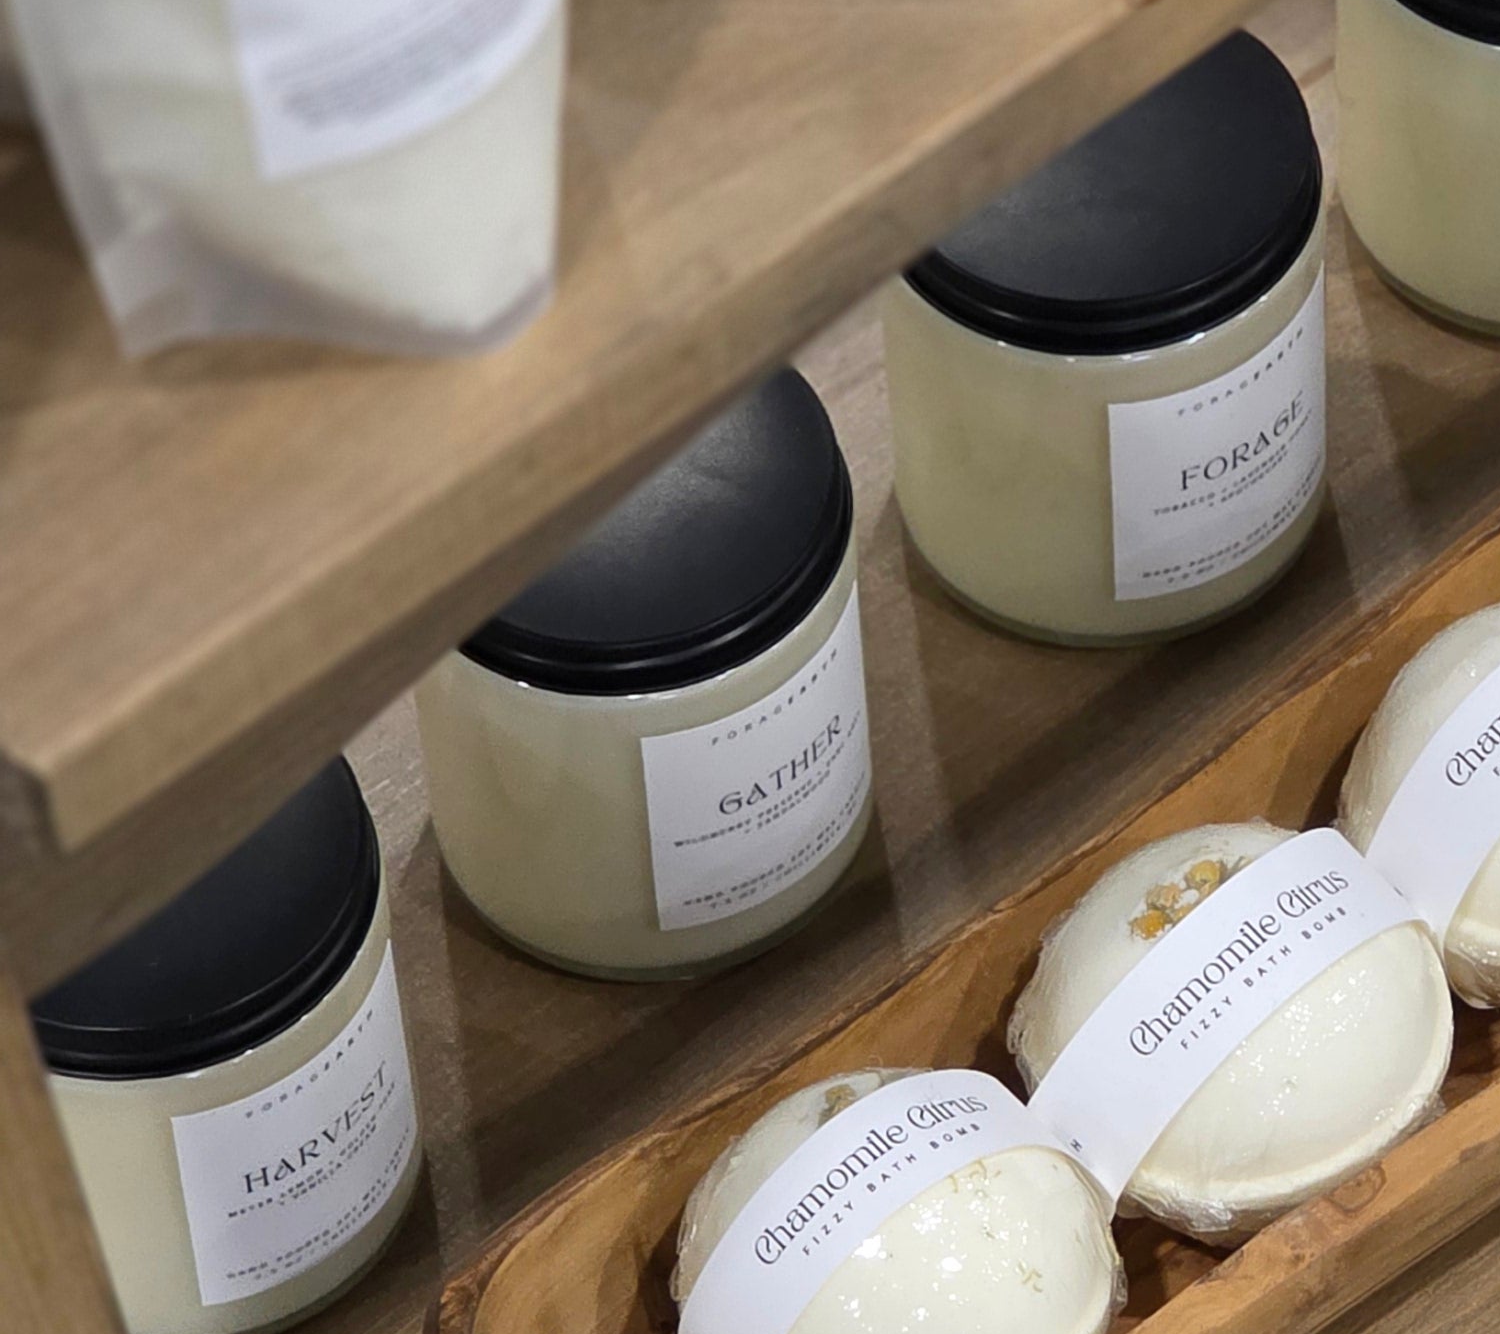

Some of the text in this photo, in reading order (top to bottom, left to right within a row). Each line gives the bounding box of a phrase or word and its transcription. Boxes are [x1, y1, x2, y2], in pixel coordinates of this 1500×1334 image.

[1152, 492, 1215, 514] TOBACCO
[1180, 390, 1305, 491] FORAGE
[719, 714, 842, 816] GATHER
[1129, 870, 1349, 1056] Chamomile Citrus
[1180, 905, 1347, 1051] FIZZY BATH BOMB
[244, 1060, 387, 1194] HARVEST
[754, 1095, 989, 1266] Chamomile Citrus
[802, 1123, 981, 1256] FIZZY BATH BOMB
